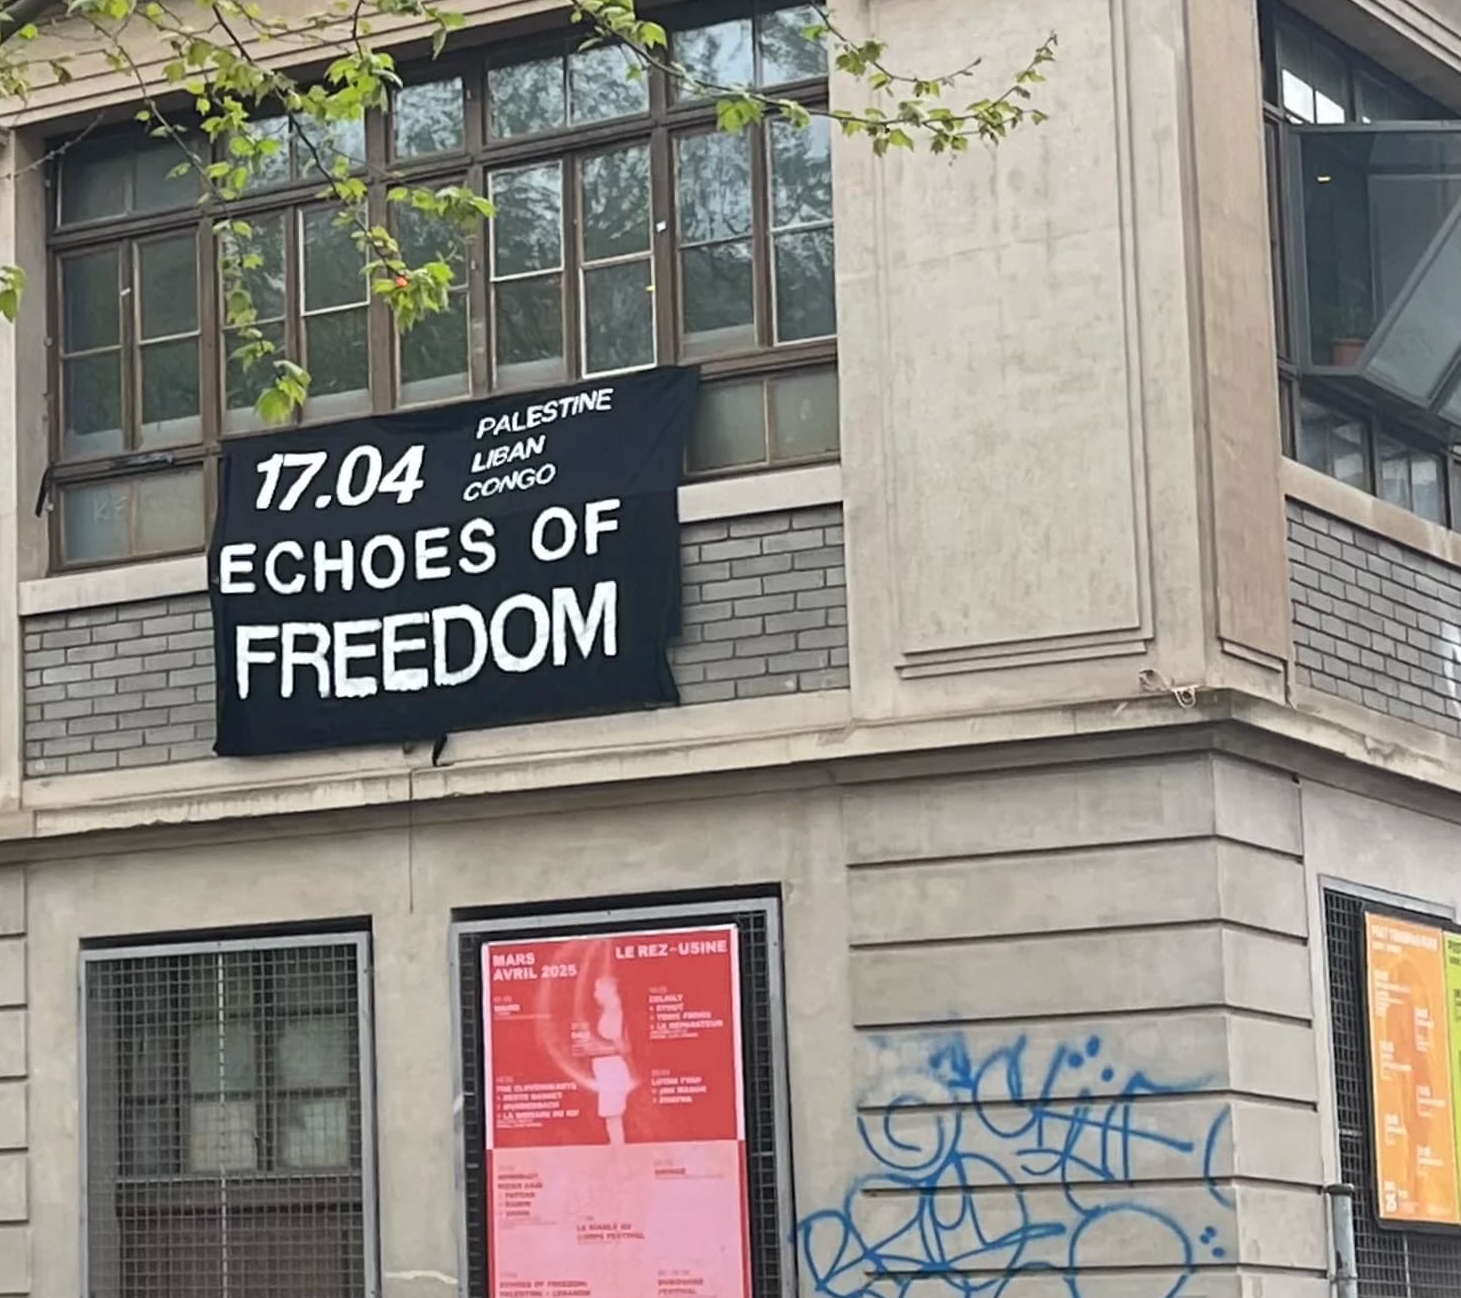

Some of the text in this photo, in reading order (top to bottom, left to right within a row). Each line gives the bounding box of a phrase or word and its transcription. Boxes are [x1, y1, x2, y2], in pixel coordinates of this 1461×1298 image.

[476, 388, 614, 439] PALESTINE
[471, 435, 546, 473] LIBAN
[255, 445, 425, 511] 17.04
[463, 464, 556, 501] CONGO
[220, 499, 621, 594] ECHOES OF
[236, 581, 618, 699] FREEDOM
[492, 952, 535, 967] MARS
[615, 946, 635, 960] LE
[492, 964, 577, 981] AVRIL 2025
